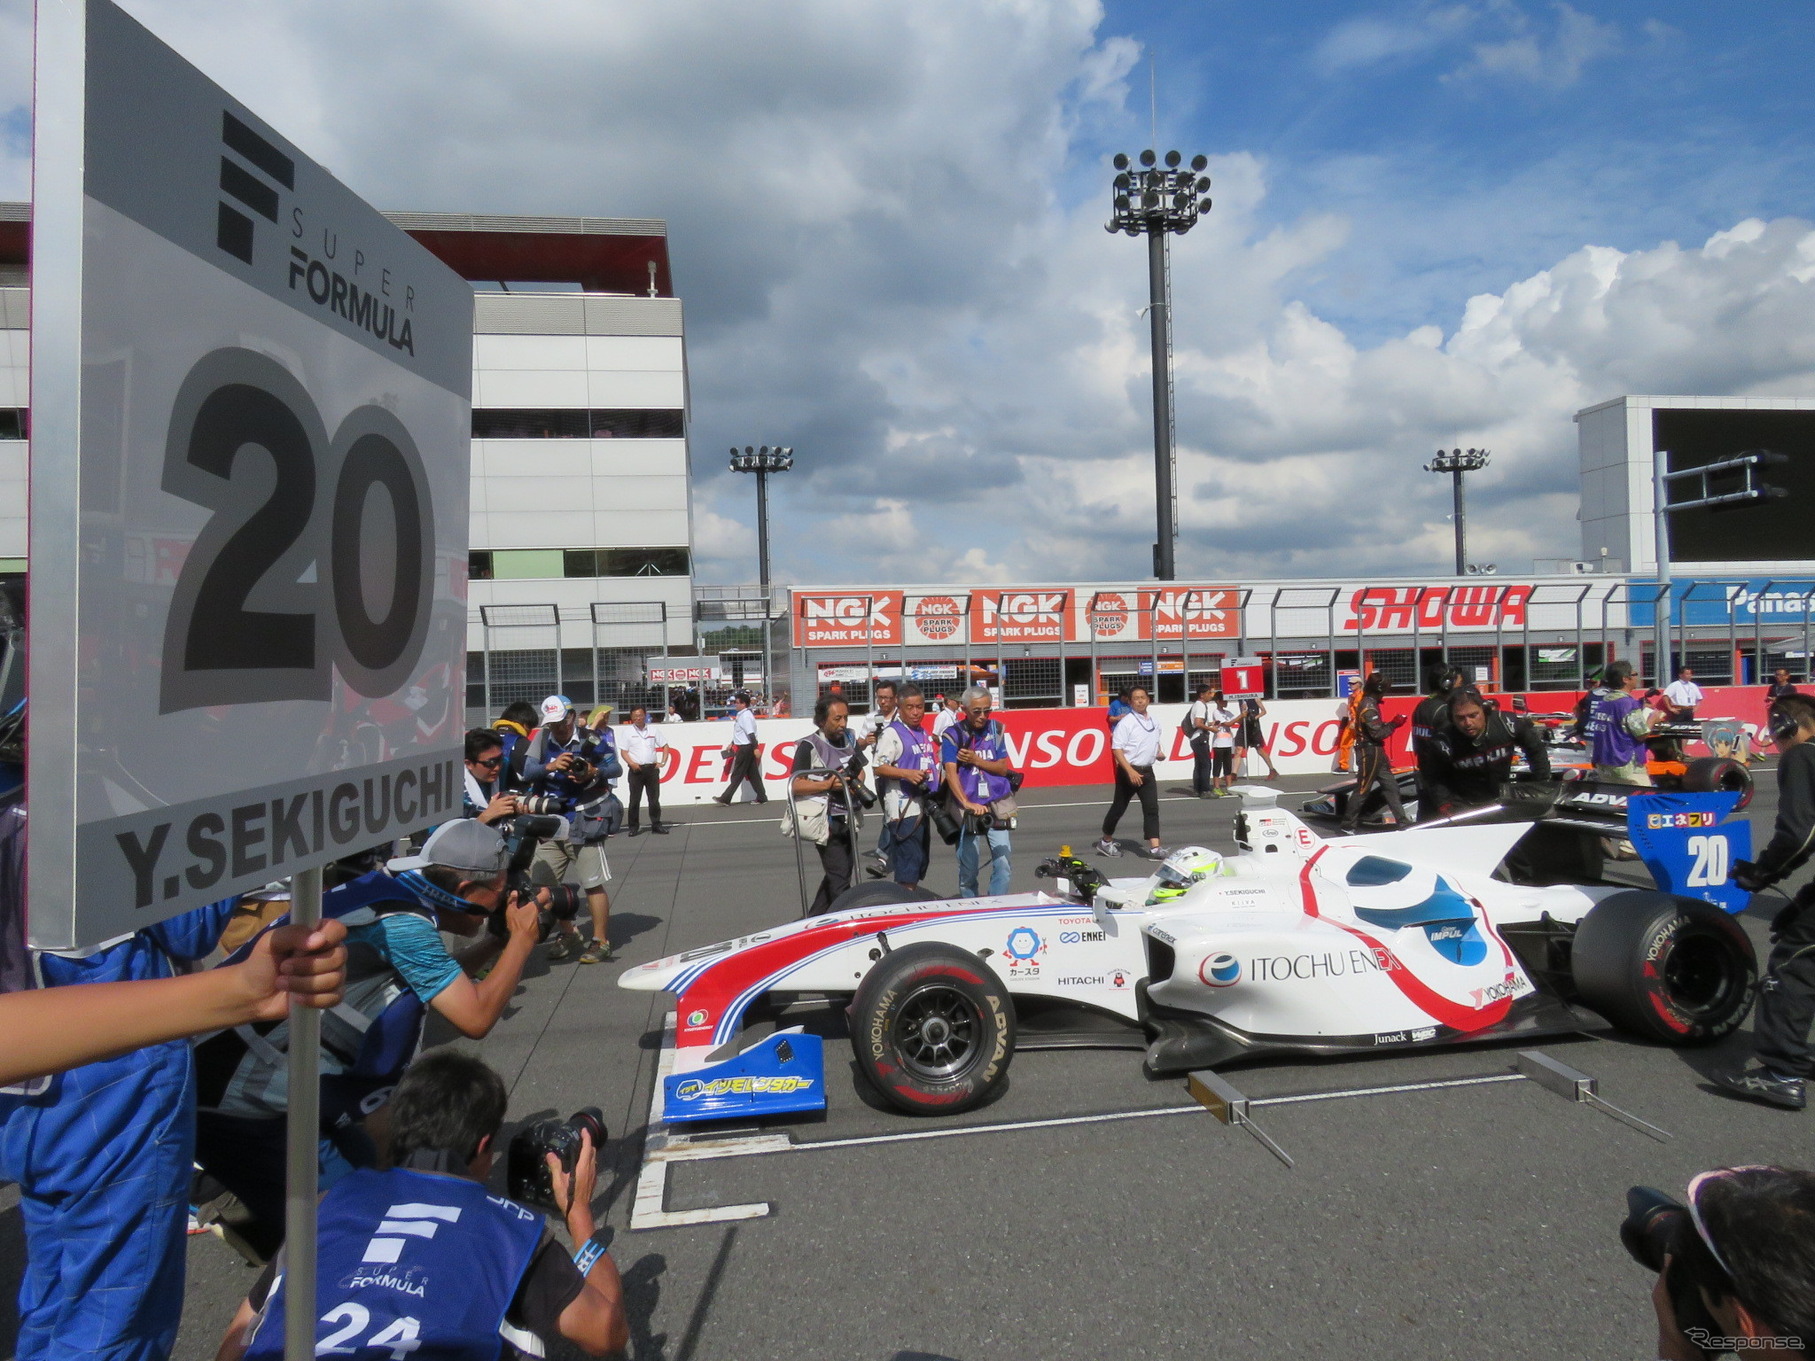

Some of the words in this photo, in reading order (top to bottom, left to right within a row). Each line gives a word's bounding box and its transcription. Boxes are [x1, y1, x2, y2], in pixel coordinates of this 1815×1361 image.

[292, 207, 415, 313] SUPER
[289, 245, 415, 358] FORMULA
[170, 363, 428, 694] 20
[807, 596, 892, 628] NGK
[921, 603, 953, 615] NGK
[982, 593, 1064, 624] NGK
[1094, 600, 1121, 611] NGK
[1153, 591, 1226, 621] NGK
[1343, 585, 1533, 630] SHOWA
[808, 630, 848, 640] SPARK
[850, 629, 892, 640] PLUGS
[983, 626, 1022, 637] SPARK
[1023, 626, 1061, 636] PLUGS
[1188, 623, 1226, 632] PLUGS
[1236, 670, 1248, 690] 1
[116, 760, 454, 909] Y.SEKIGUCHI
[1298, 829, 1311, 844] E
[1686, 835, 1728, 887] 20
[1081, 931, 1107, 942] ENKEI
[1430, 929, 1463, 941] IMPUL
[1009, 967, 1040, 977] カースタ
[1251, 950, 1346, 982] ITOCHU
[1352, 947, 1402, 974] ENEX
[1057, 976, 1105, 986] HITACHI
[1484, 975, 1527, 1001] YOKOHAMA
[871, 989, 899, 1061] YOKOHAMA
[982, 995, 1008, 1083] ADVAN
[1374, 1031, 1408, 1045] Junack
[349, 1274, 425, 1298] FORMULA
[356, 1266, 429, 1286] SUPER
[316, 1302, 422, 1361] 24
